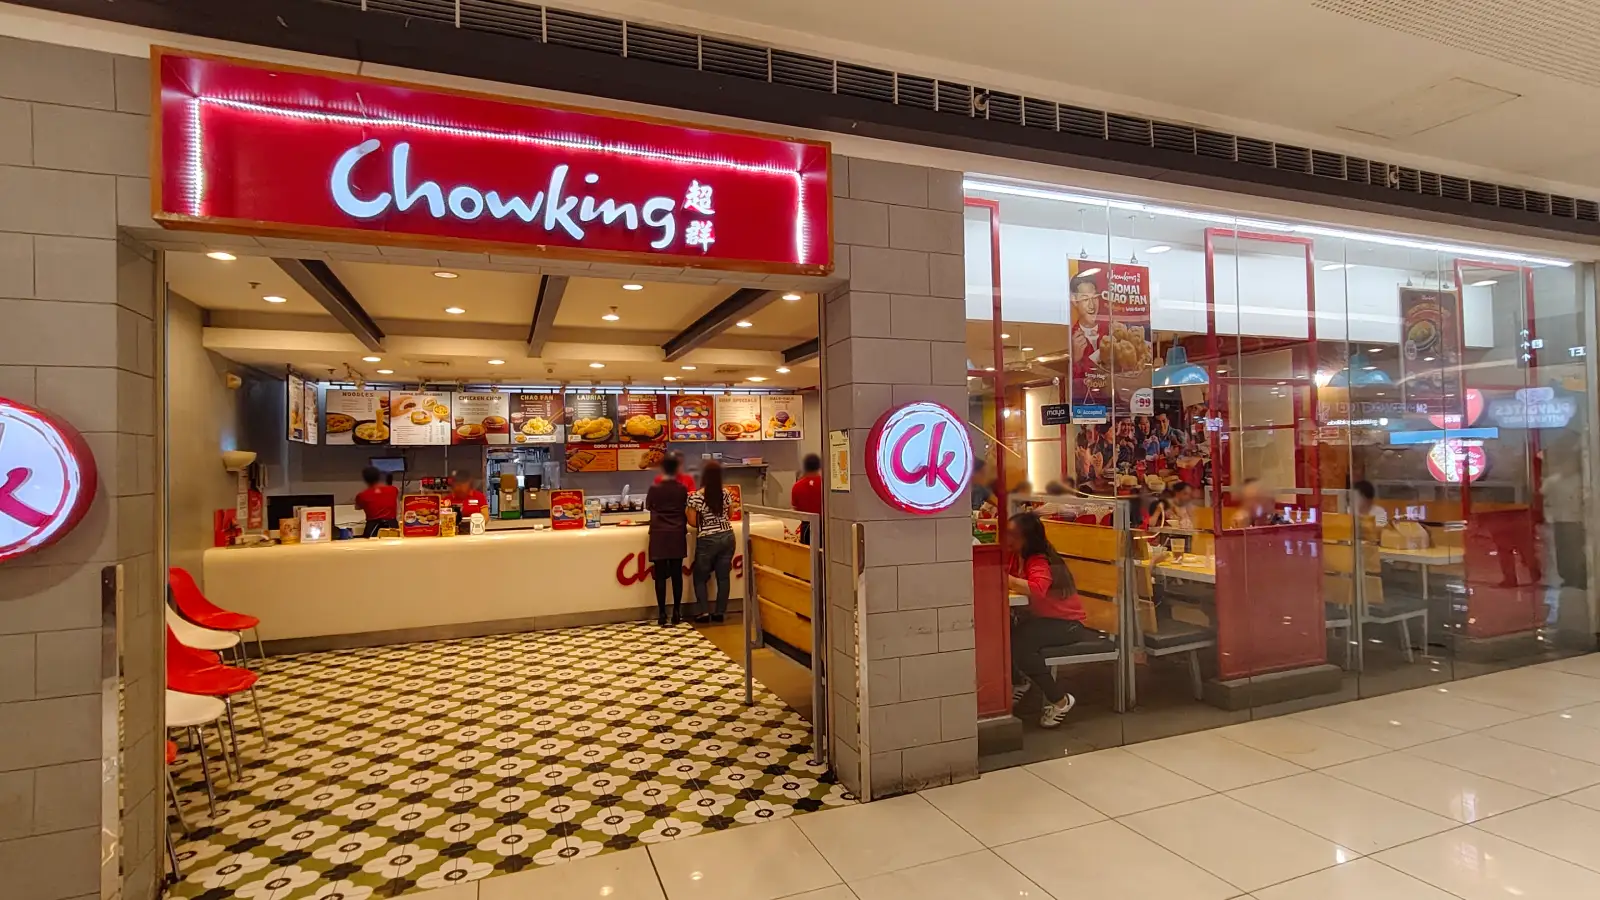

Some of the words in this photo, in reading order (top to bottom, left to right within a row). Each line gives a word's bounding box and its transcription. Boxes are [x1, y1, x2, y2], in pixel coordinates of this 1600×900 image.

[330, 138, 676, 249] Chowking
[1108, 282, 1140, 295] SIOMAI
[1129, 294, 1148, 306] FAN
[1046, 408, 1065, 417] maya
[890, 420, 961, 495] Ck
